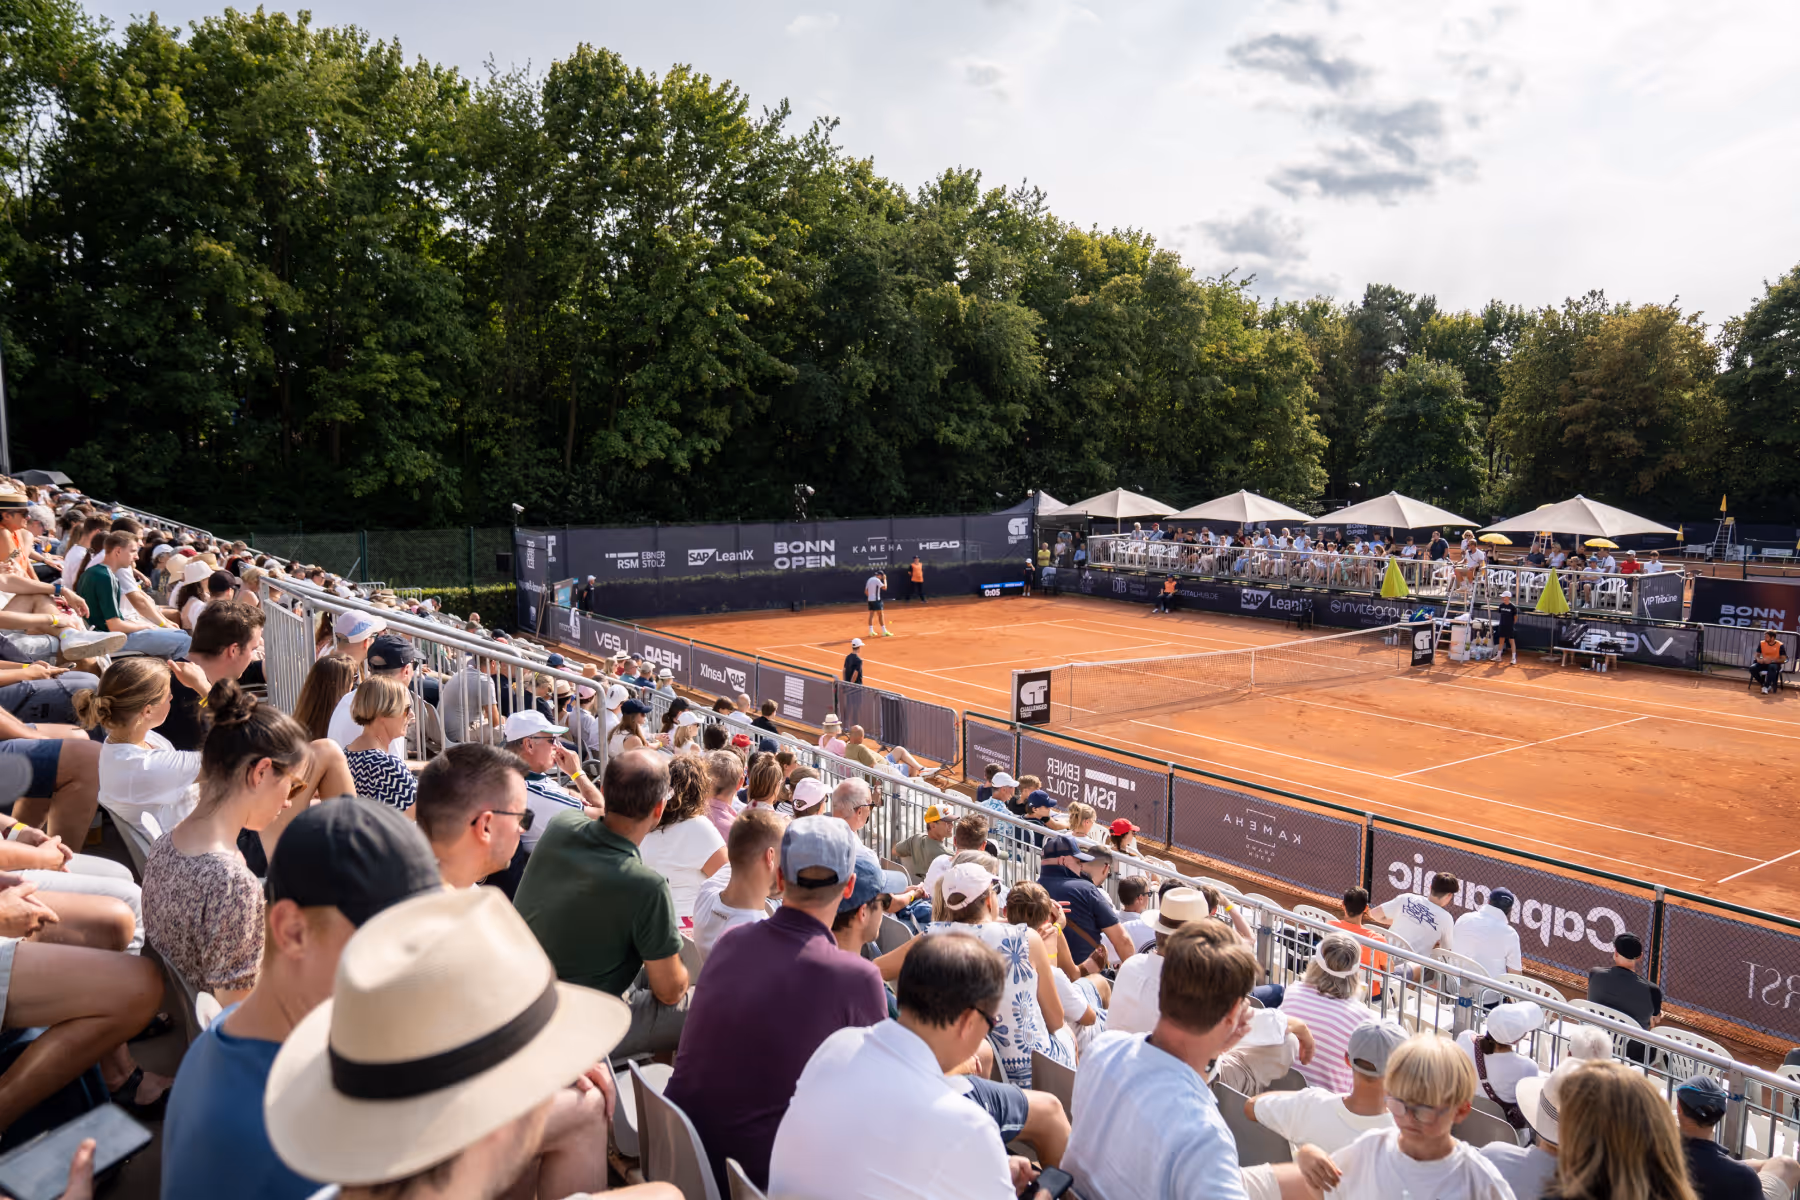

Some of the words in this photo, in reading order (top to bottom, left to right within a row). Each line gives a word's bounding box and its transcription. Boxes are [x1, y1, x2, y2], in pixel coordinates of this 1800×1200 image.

[774, 540, 835, 554] BONN
[852, 543, 902, 554] KAMEHA
[919, 540, 960, 550] HEAD
[642, 551, 665, 560] EBNER
[688, 552, 711, 563] SAP
[716, 549, 754, 562] LeanIX
[617, 559, 639, 569] RSM
[642, 559, 665, 568] STOLZ
[774, 554, 835, 570] OPEN
[1112, 577, 1126, 594] DTB
[984, 589, 1001, 597] 0:05
[1242, 592, 1264, 606] SAP
[1720, 604, 1786, 620] BONN
[1020, 704, 1048, 713] CHALLENGER
